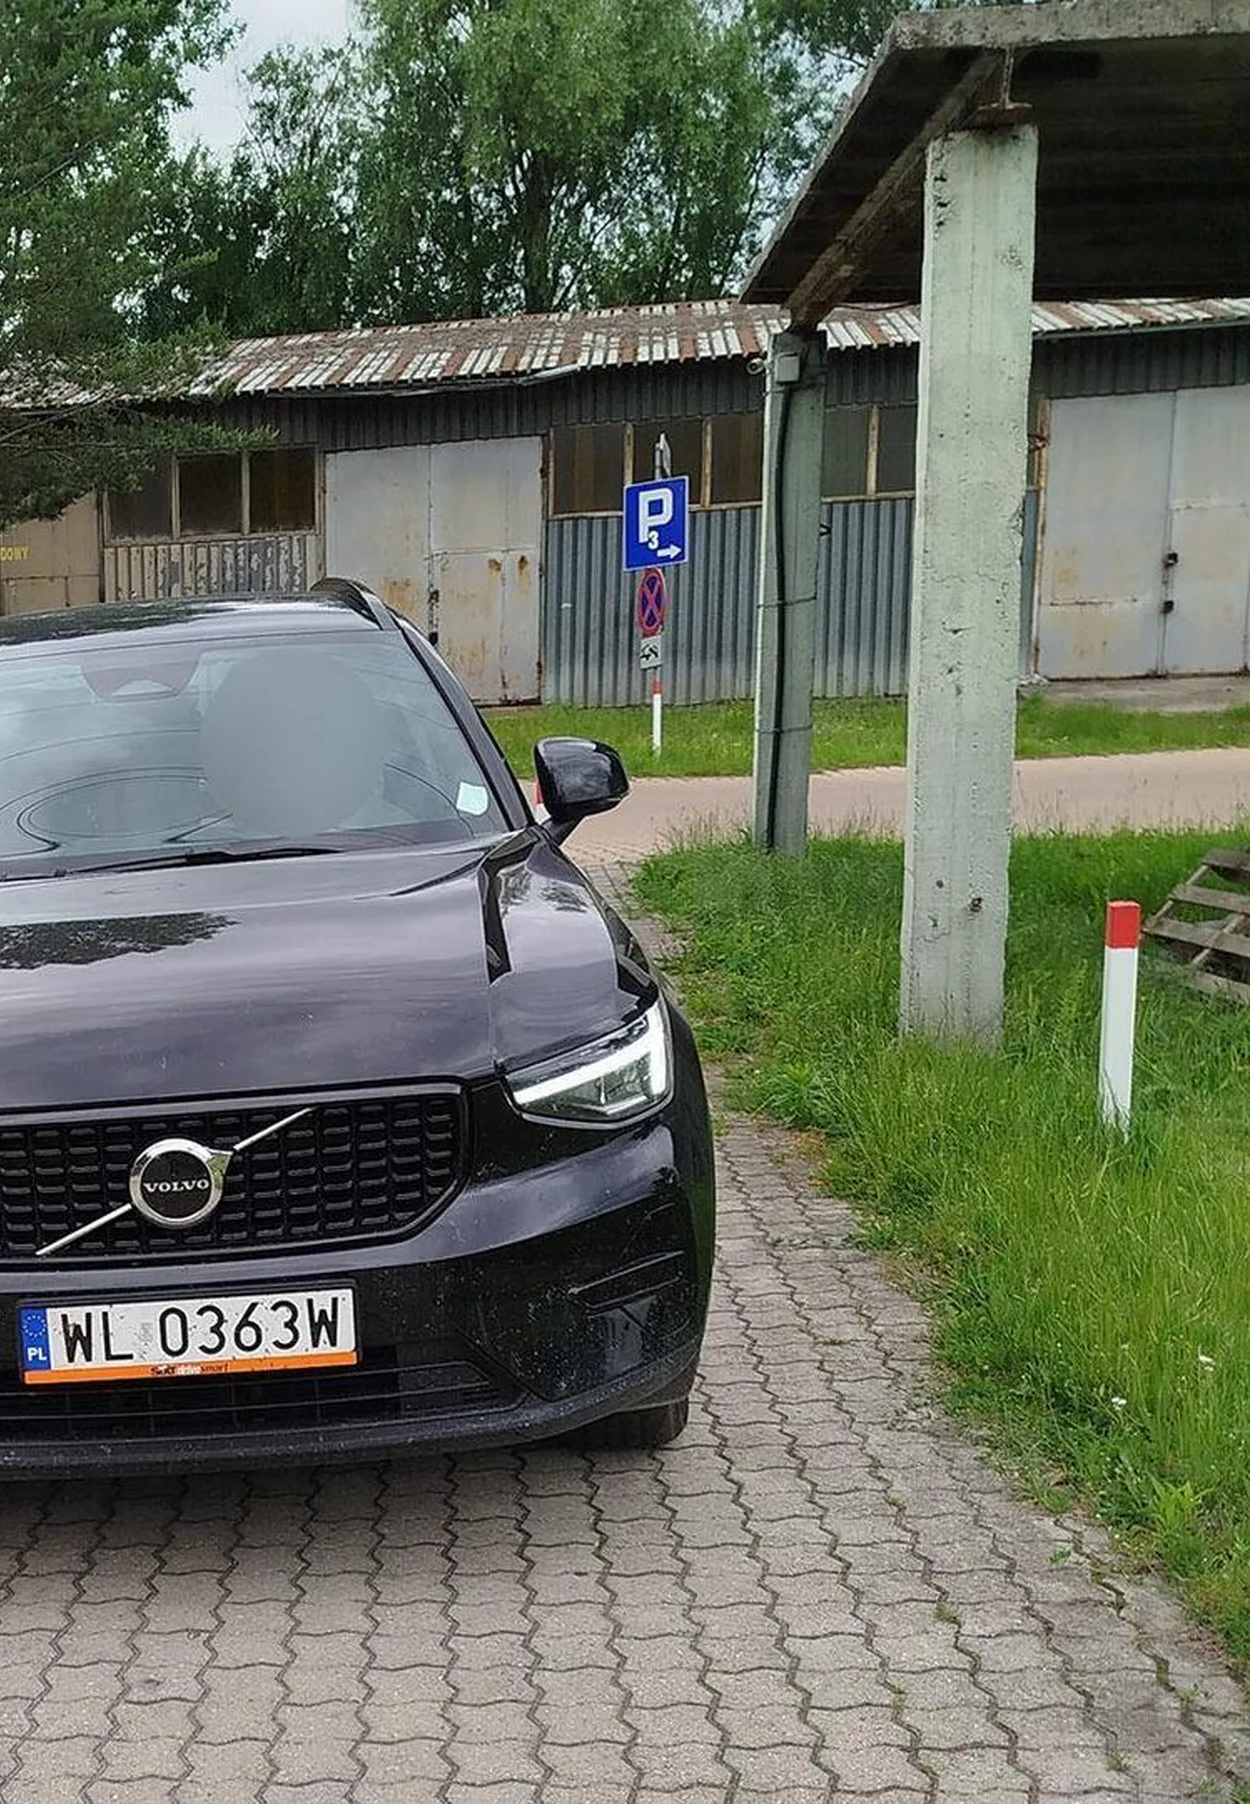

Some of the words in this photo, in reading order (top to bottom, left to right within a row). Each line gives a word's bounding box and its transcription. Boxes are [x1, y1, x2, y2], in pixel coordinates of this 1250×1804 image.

[638, 488, 673, 543] P
[648, 530, 659, 549] 3
[143, 1179, 210, 1193] VOLVO
[60, 1311, 134, 1363] WL
[158, 1297, 339, 1358] 0363W
[27, 1347, 47, 1361] PL
